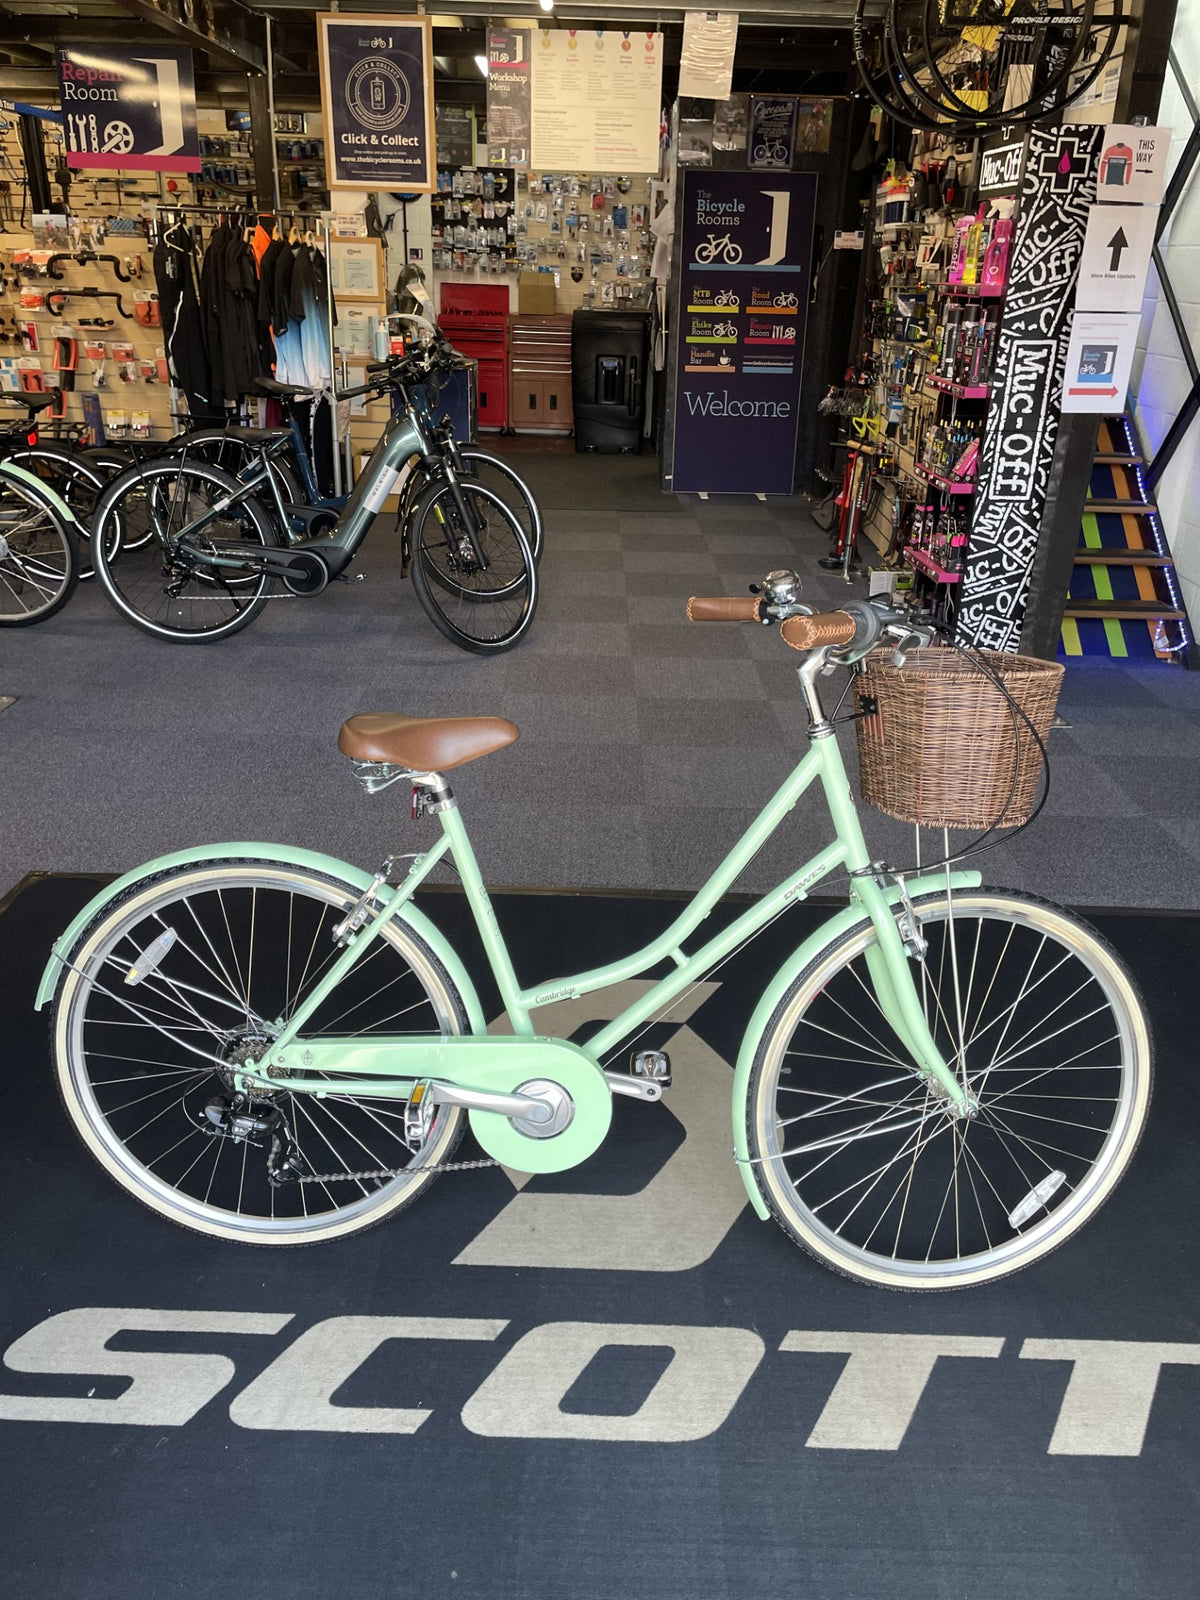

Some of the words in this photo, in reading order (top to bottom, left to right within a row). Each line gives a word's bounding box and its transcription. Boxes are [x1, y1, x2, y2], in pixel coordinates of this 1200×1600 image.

[489, 72, 528, 84] Workshop
[63, 81, 119, 101] Room
[489, 82, 511, 91] Menu
[341, 133, 368, 145] Click
[370, 134, 379, 145] &
[381, 134, 420, 146] Collect
[1138, 139, 1155, 150] THIS
[1135, 152, 1153, 163] WAY
[697, 189, 712, 199] The
[696, 198, 746, 214] Bicycle
[696, 212, 740, 225] Rooms
[751, 291, 770, 299] Road
[692, 320, 712, 329] Ebike
[691, 328, 712, 336] Room
[749, 329, 770, 337] Room
[690, 350, 715, 358] Handle
[683, 389, 791, 418] Welcome
[997, 348, 1049, 494] Muc-Off
[783, 864, 826, 900] DAWES
[535, 986, 576, 1004] Cambridge
[0, 1307, 1200, 1456] SCOTT
